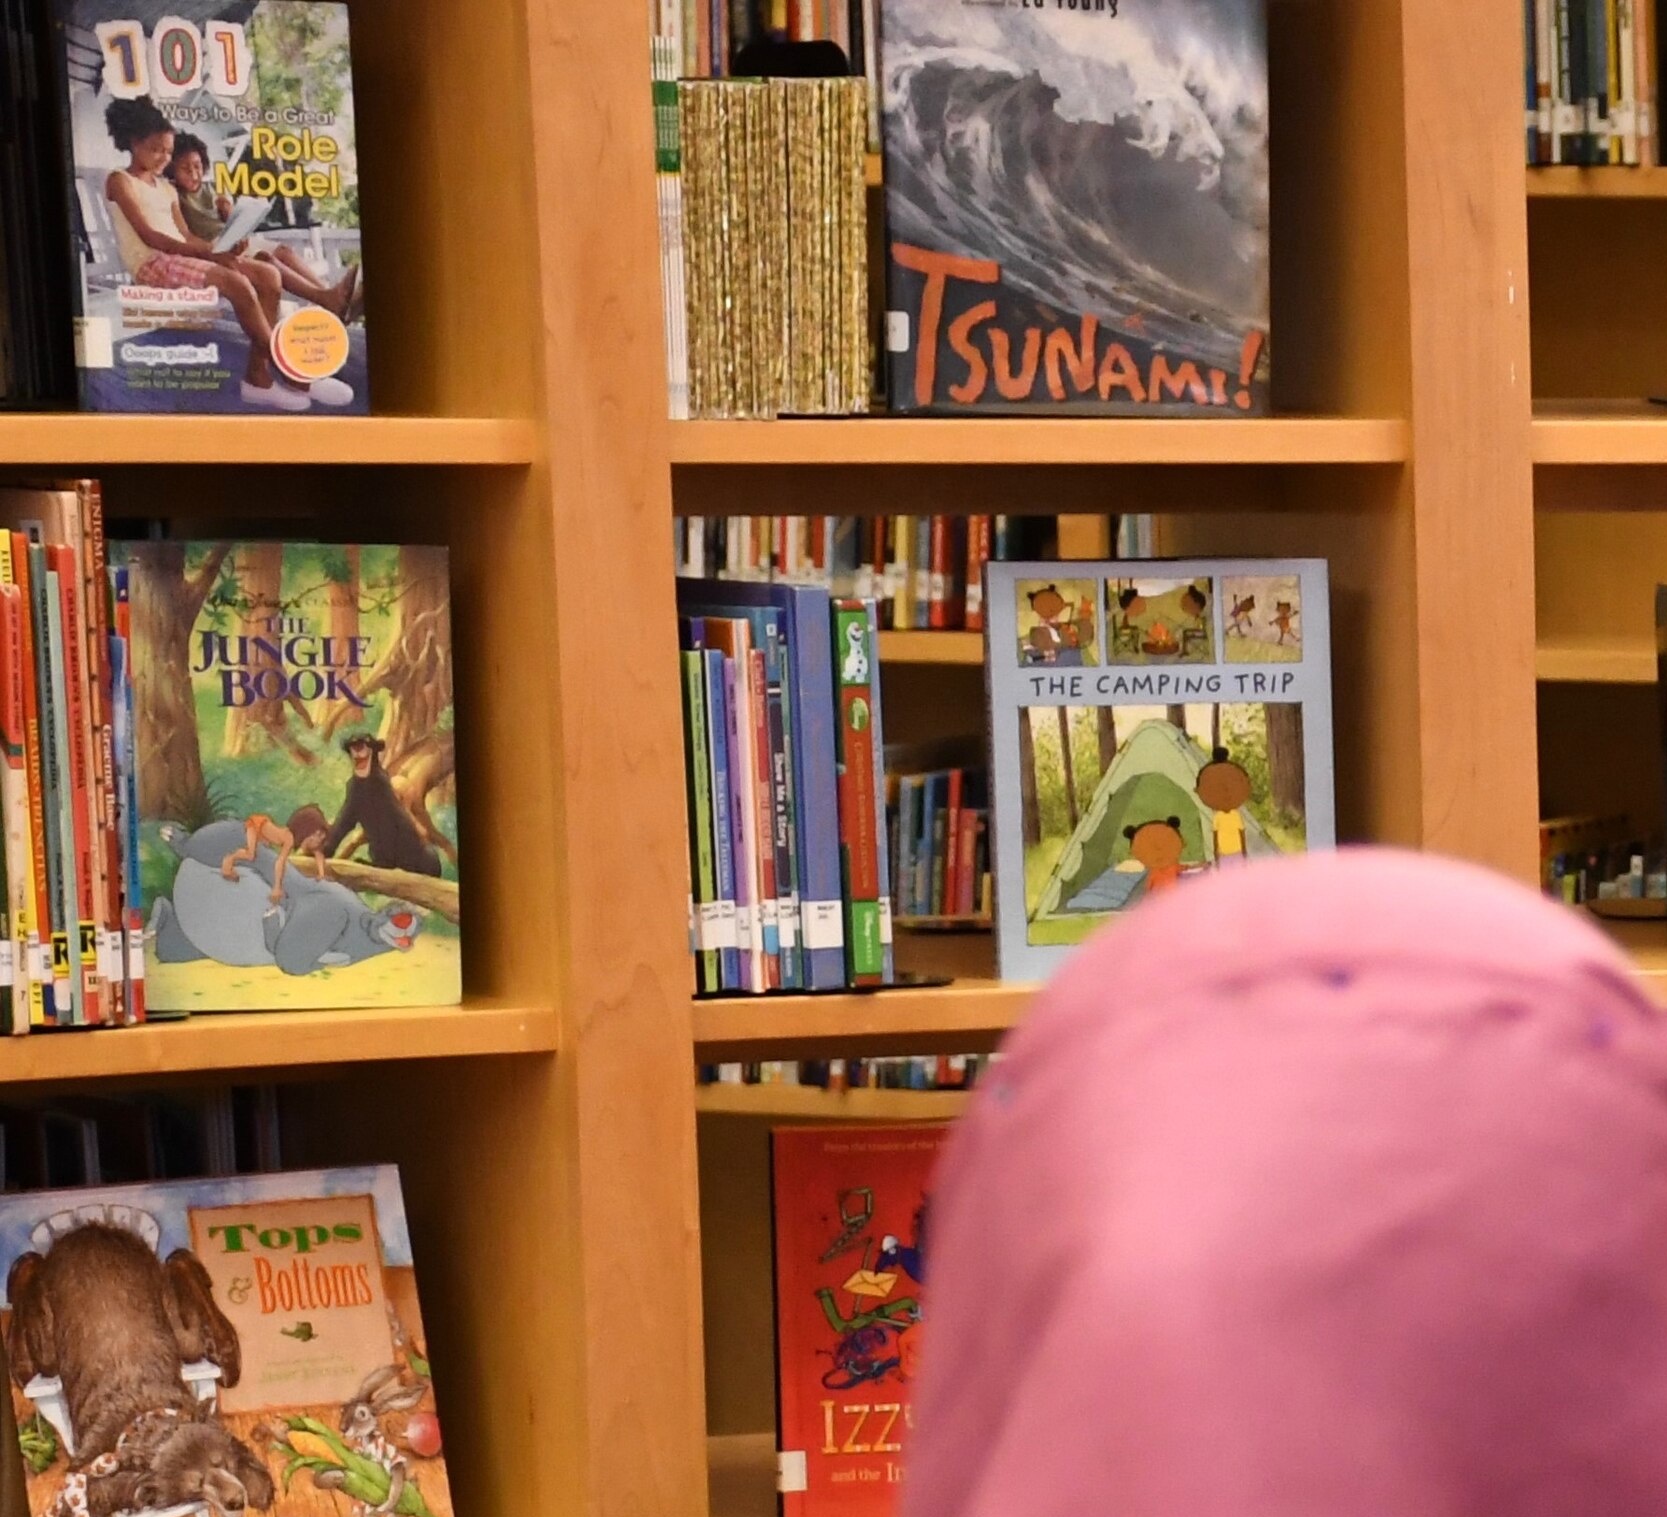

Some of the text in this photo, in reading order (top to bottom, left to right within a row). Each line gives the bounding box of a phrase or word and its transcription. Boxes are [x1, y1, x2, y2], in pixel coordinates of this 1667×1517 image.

[108, 28, 237, 86] 101
[160, 104, 336, 125] Ways to Be a Great
[252, 127, 338, 162] Role
[214, 162, 340, 199] Model
[91, 492, 104, 570] ENIGMA
[266, 617, 311, 634] THE
[193, 630, 377, 673] JUNGLE
[219, 669, 375, 708] BOOK
[1030, 672, 1295, 697] THE CAMPING TRIP
[102, 724, 114, 789] Graeme
[208, 1222, 363, 1253] Tops
[228, 1256, 373, 1314] & Bottoms
[820, 1398, 913, 1454] IZZ
